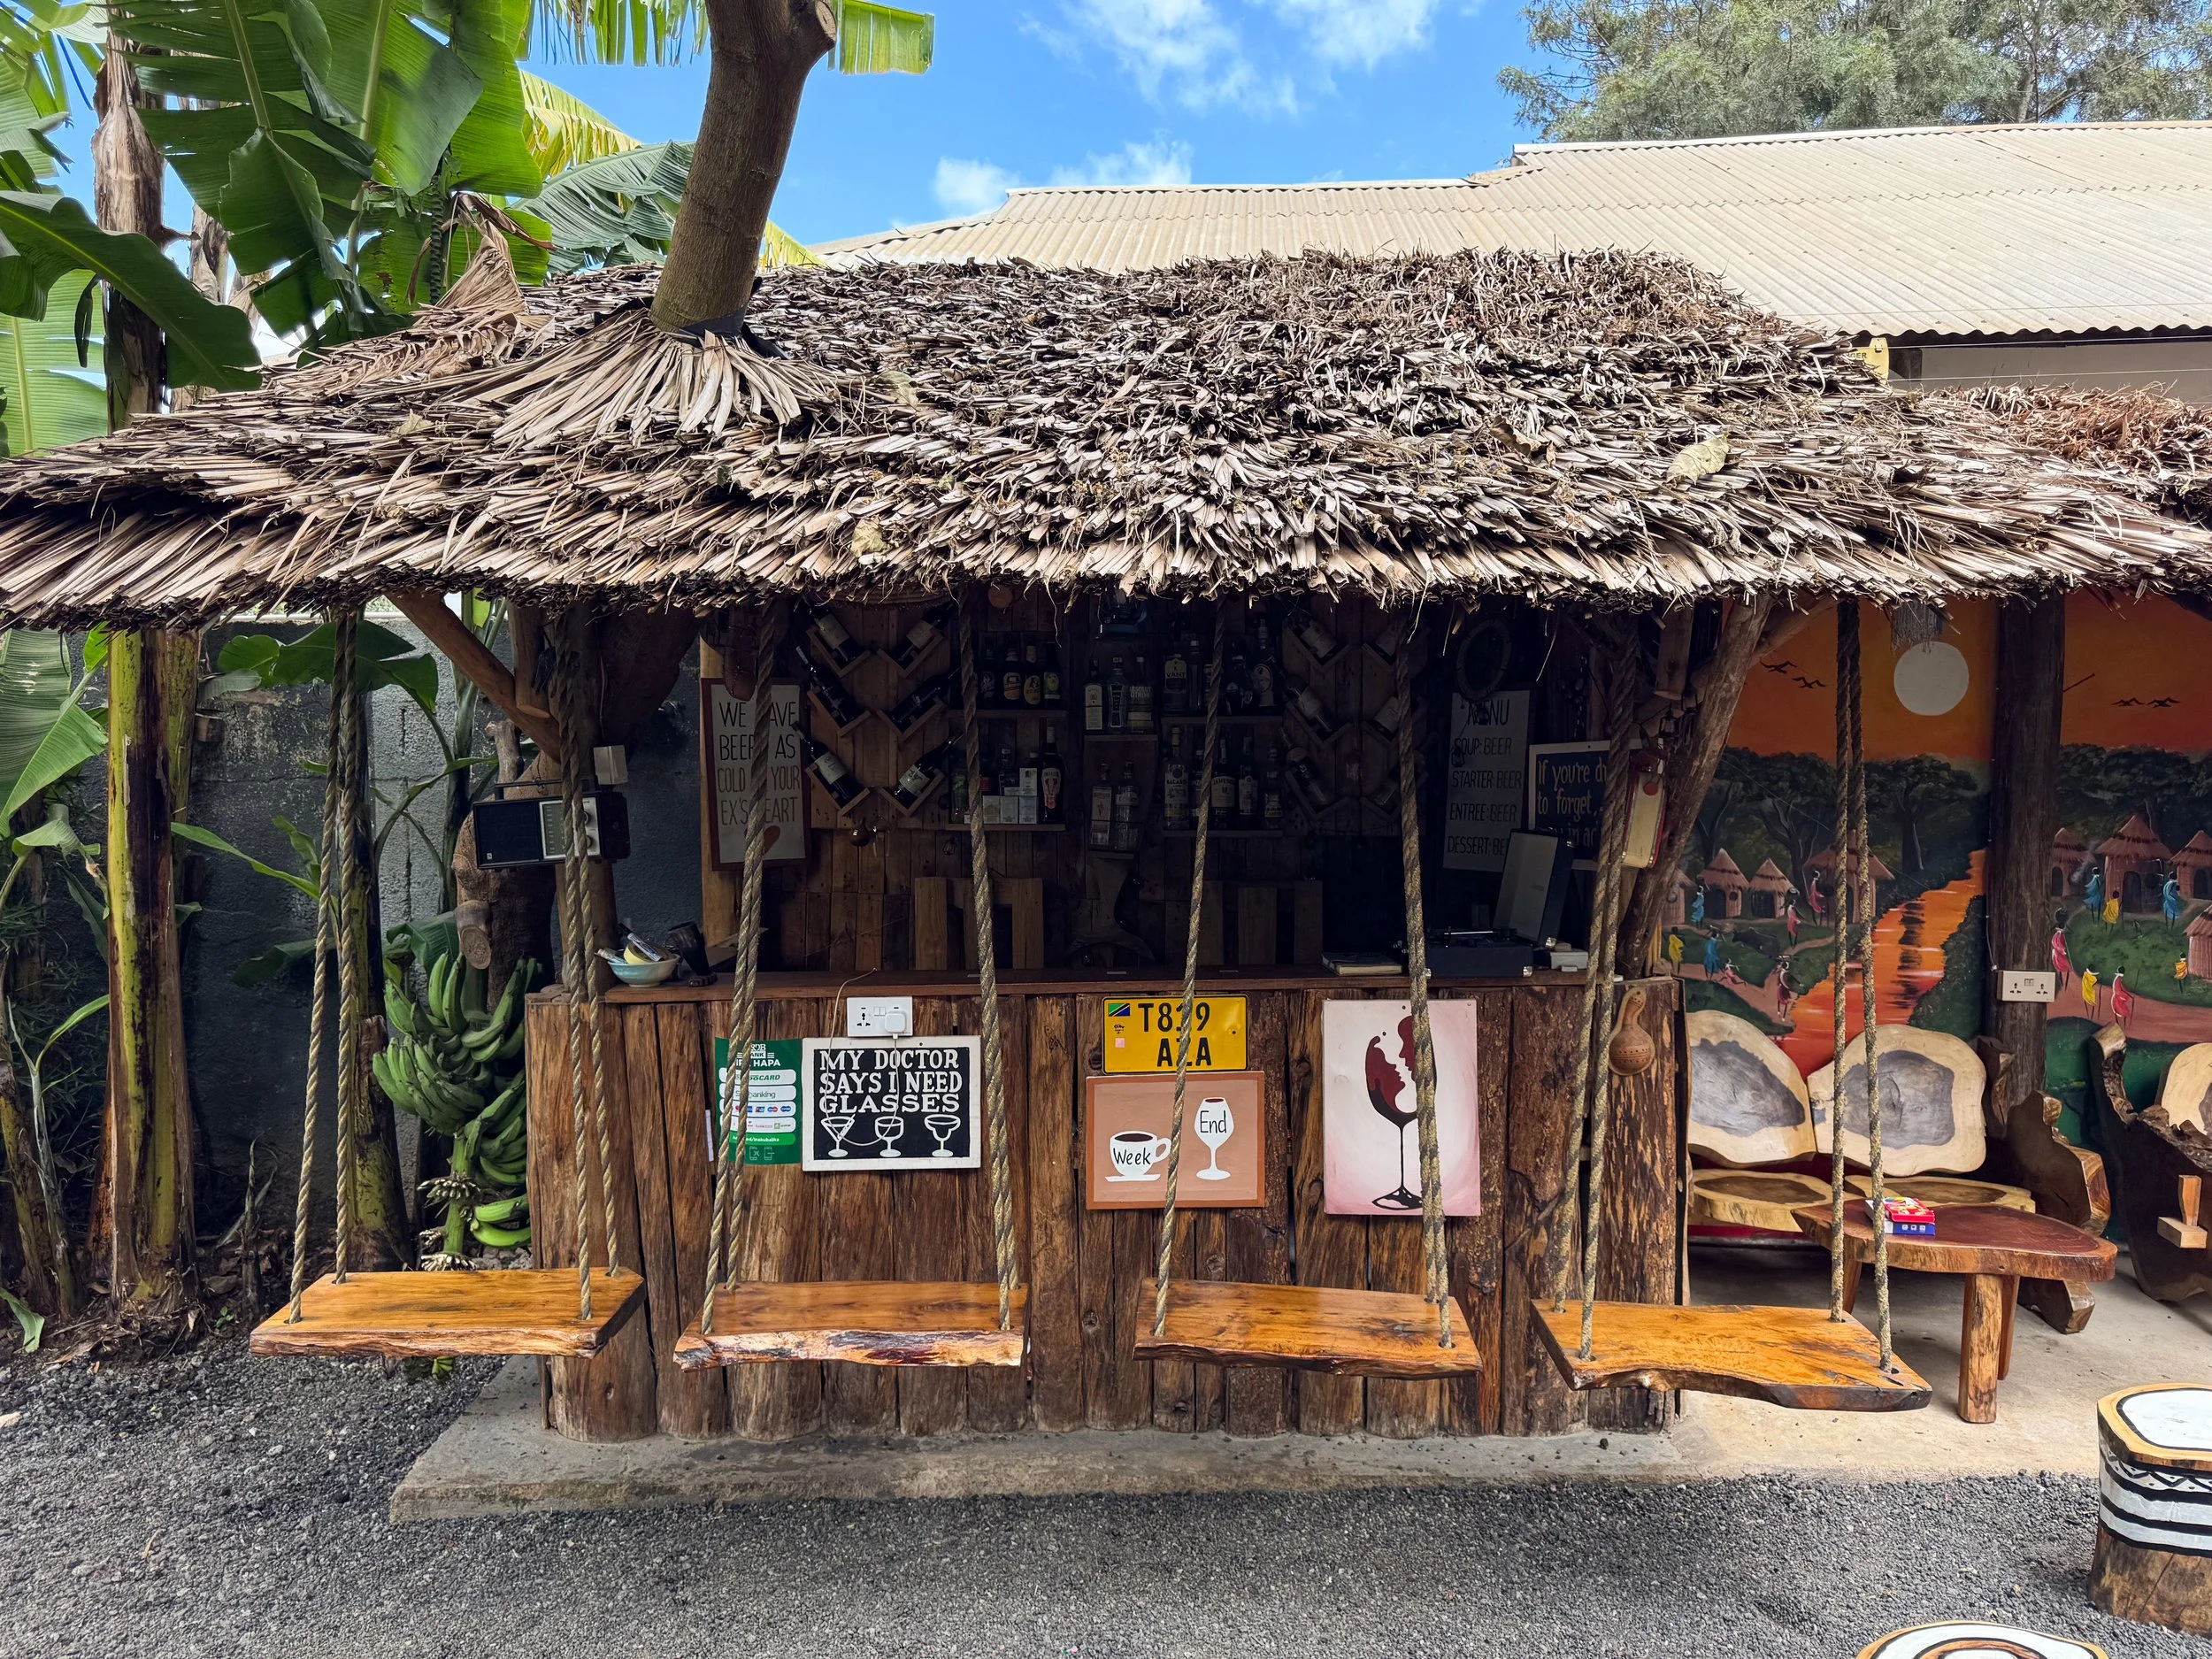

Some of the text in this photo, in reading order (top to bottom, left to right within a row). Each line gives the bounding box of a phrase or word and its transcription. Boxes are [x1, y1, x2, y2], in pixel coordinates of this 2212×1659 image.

[718, 702, 796, 727] WE AVE
[1467, 699, 1509, 726] MNU
[774, 733, 795, 759] AS
[1484, 737, 1512, 756] BEER
[717, 765, 801, 793] COLD YOUR
[1496, 770, 1523, 789] BEER
[1538, 759, 1549, 786] If
[720, 796, 798, 826] EX'S EART
[1489, 803, 1517, 822] BEER
[1537, 790, 1548, 814] to
[1138, 1002, 1210, 1033] T89
[753, 1058, 781, 1067] HAPA
[819, 1049, 959, 1071] MY DOCTOR
[1156, 1037, 1212, 1067] AA
[819, 1071, 963, 1094] SAYS I NEED
[819, 1094, 960, 1114] GLASSES
[1200, 1110, 1227, 1133] End
[1112, 1147, 1151, 1165] Week
